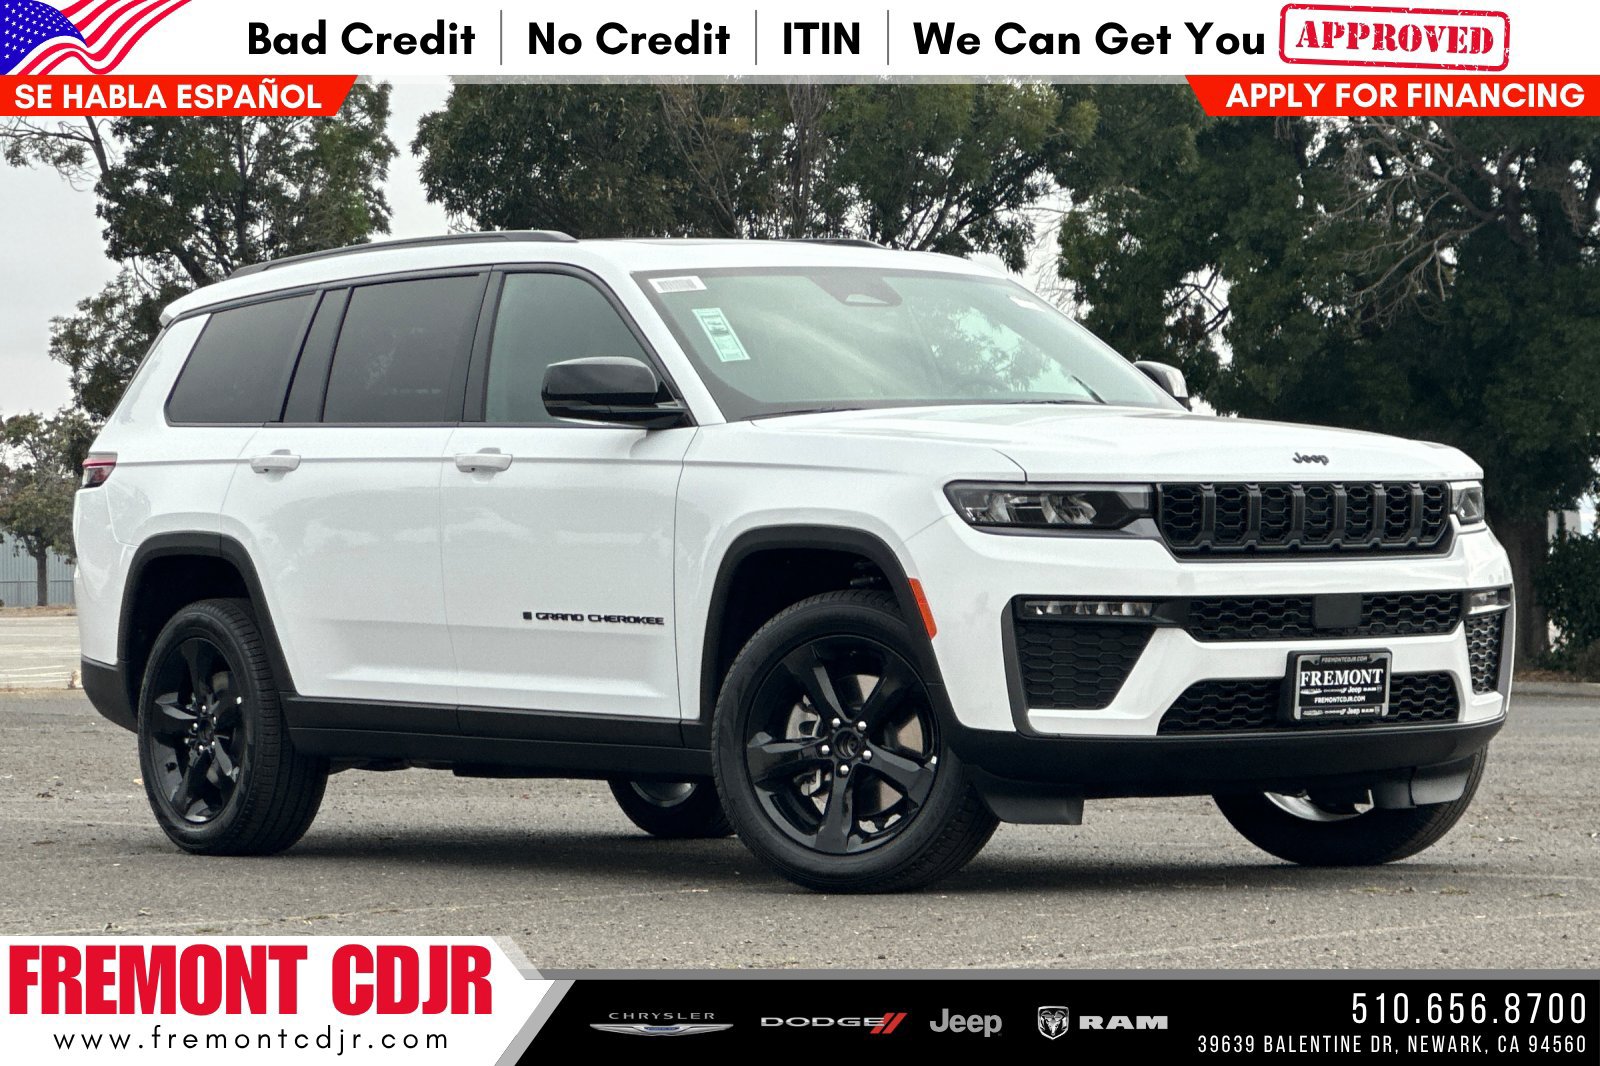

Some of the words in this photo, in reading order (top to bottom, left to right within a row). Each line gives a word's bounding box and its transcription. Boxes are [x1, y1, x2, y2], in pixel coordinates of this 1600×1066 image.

[1292, 452, 1329, 466] Jeep
[535, 612, 584, 622] GRAND
[588, 614, 665, 625] CHEROKEE
[1300, 669, 1383, 686] FREMONT
